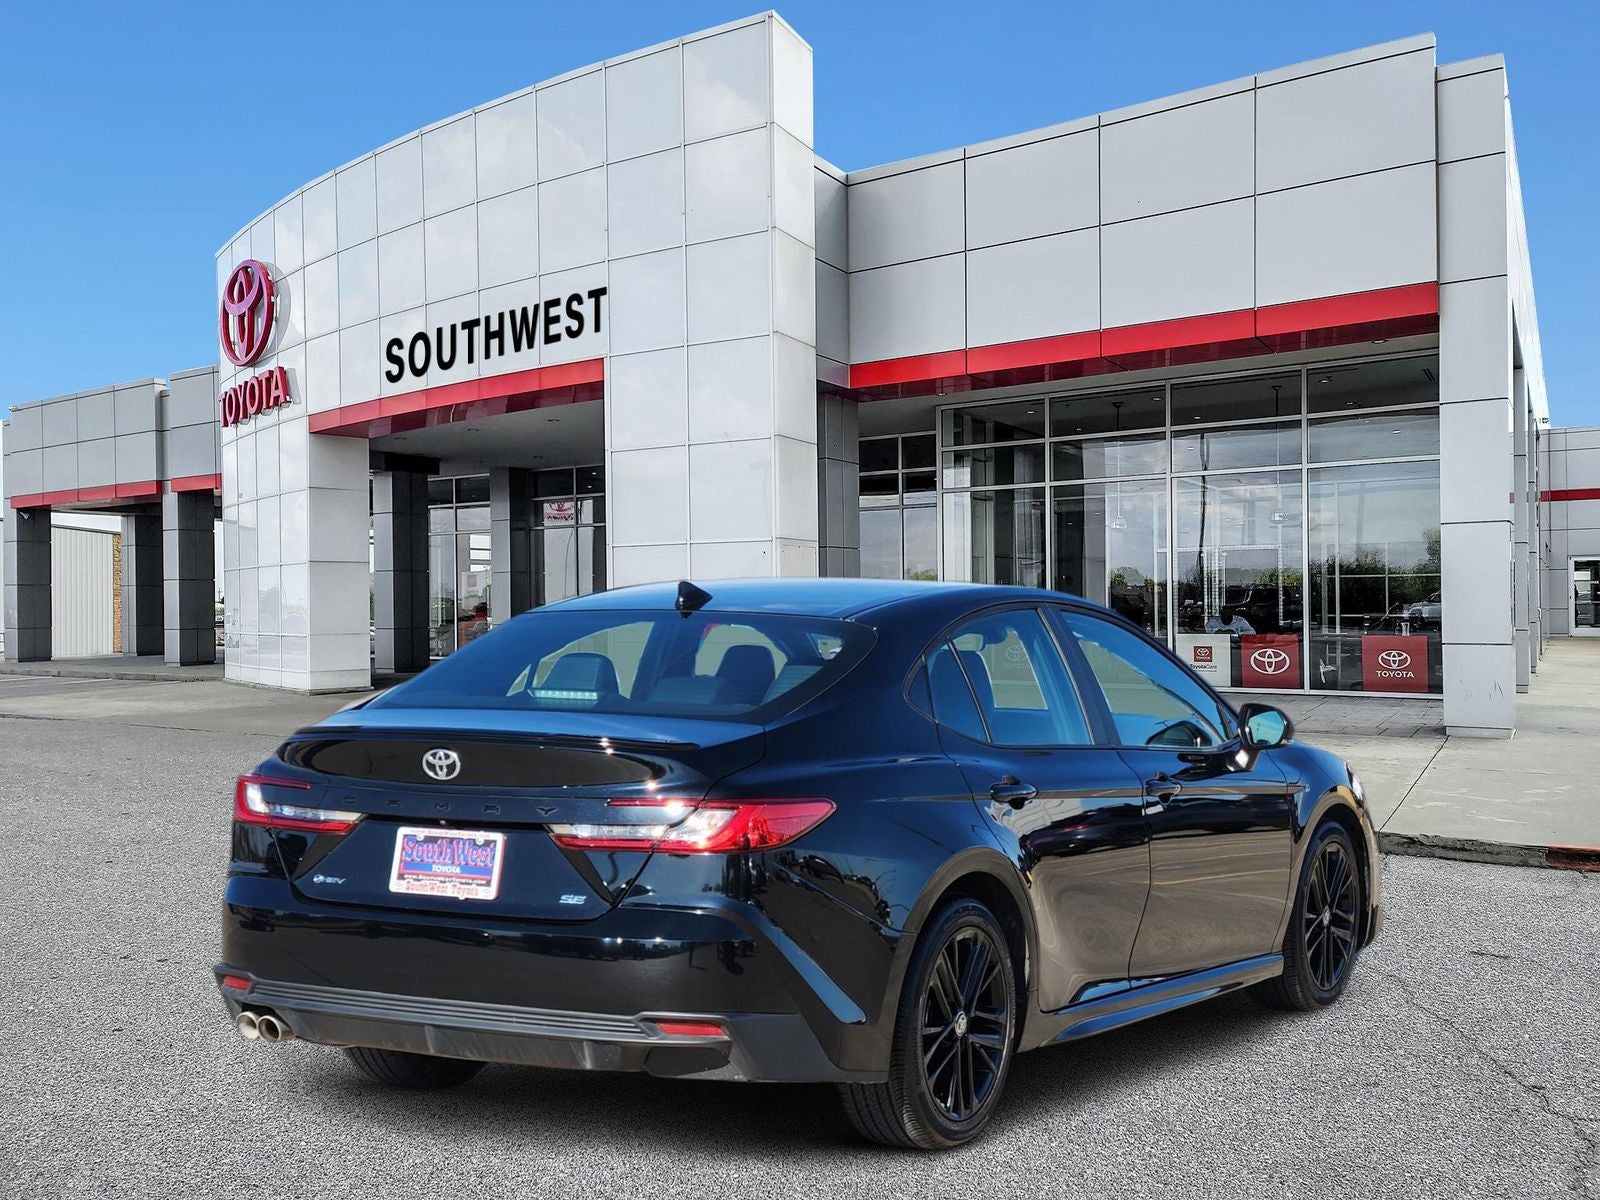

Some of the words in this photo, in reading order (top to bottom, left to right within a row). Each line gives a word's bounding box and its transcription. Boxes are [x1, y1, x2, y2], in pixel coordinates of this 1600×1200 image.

[385, 286, 608, 384] SOUTHWEST
[219, 366, 291, 428] TOYOTA
[1376, 670, 1414, 678] TOYOTA
[402, 835, 496, 868] SouthWest
[432, 864, 461, 874] TOYOTA
[451, 883, 480, 898] Toyota
[559, 894, 587, 905] SE
